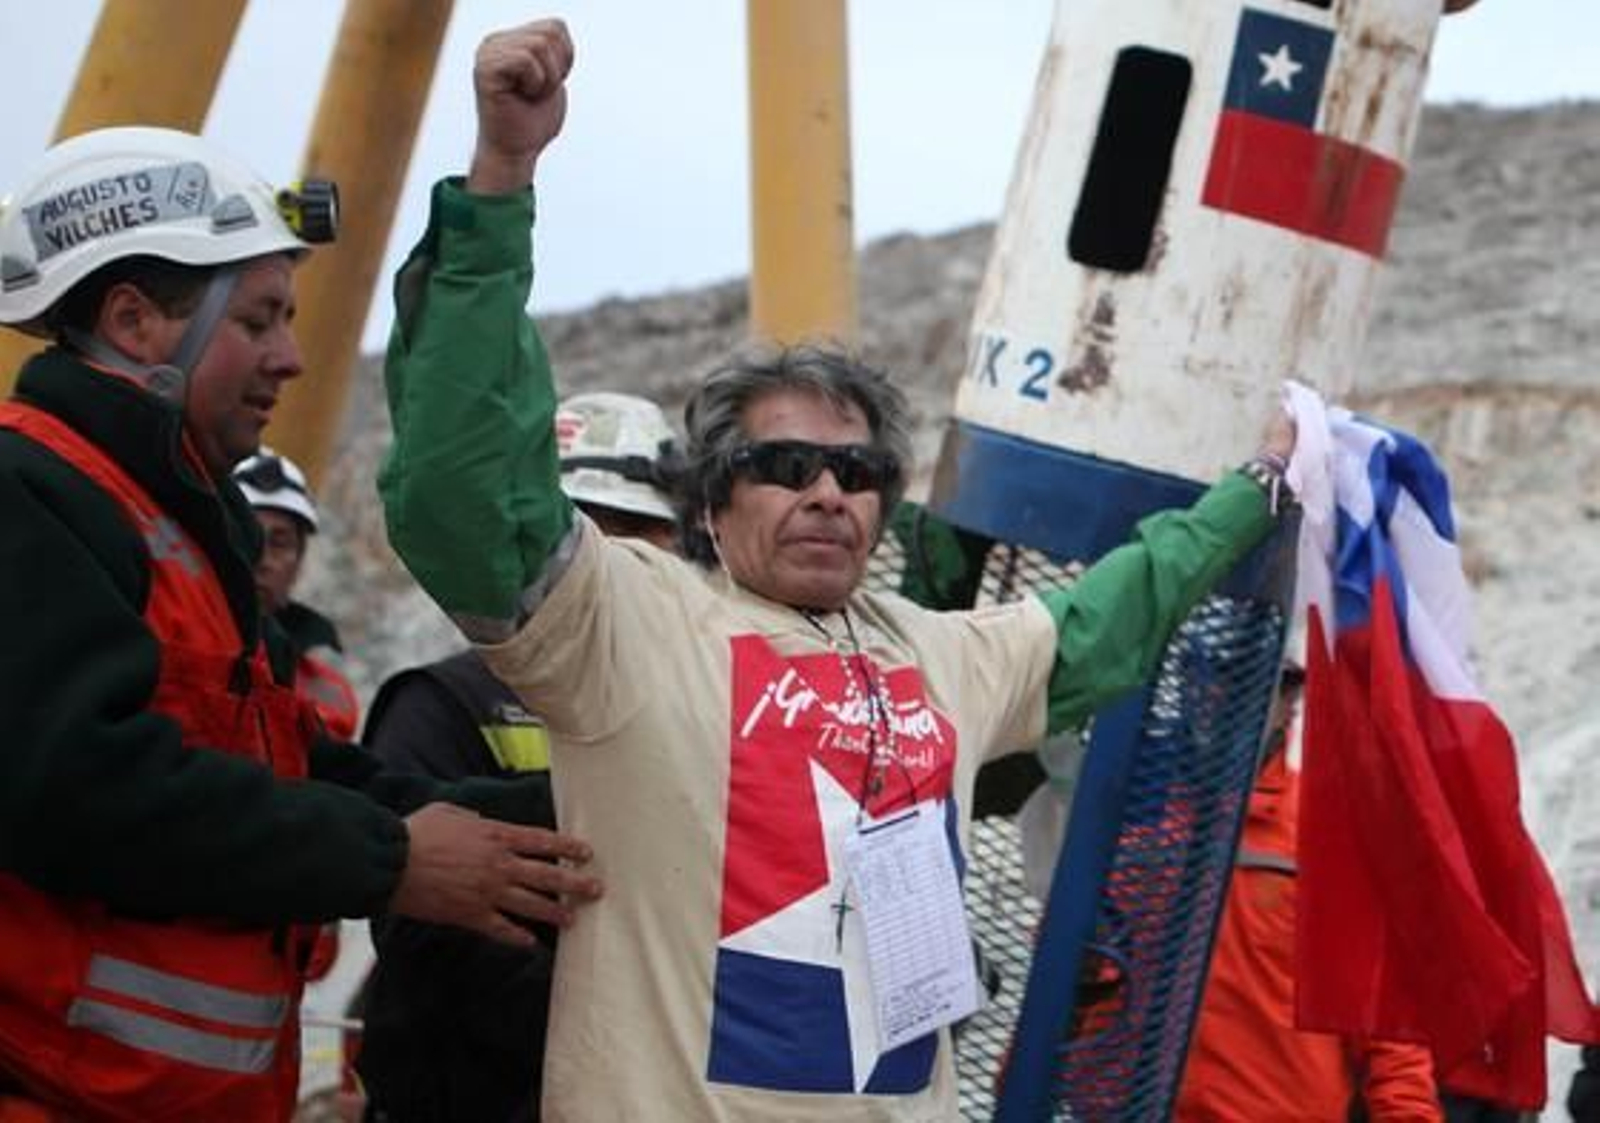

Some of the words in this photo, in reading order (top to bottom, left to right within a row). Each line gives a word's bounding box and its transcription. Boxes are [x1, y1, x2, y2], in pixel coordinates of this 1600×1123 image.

[39, 171, 151, 225] AUGUSTO
[44, 196, 159, 250] VILCHES
[1019, 349, 1053, 402] 2
